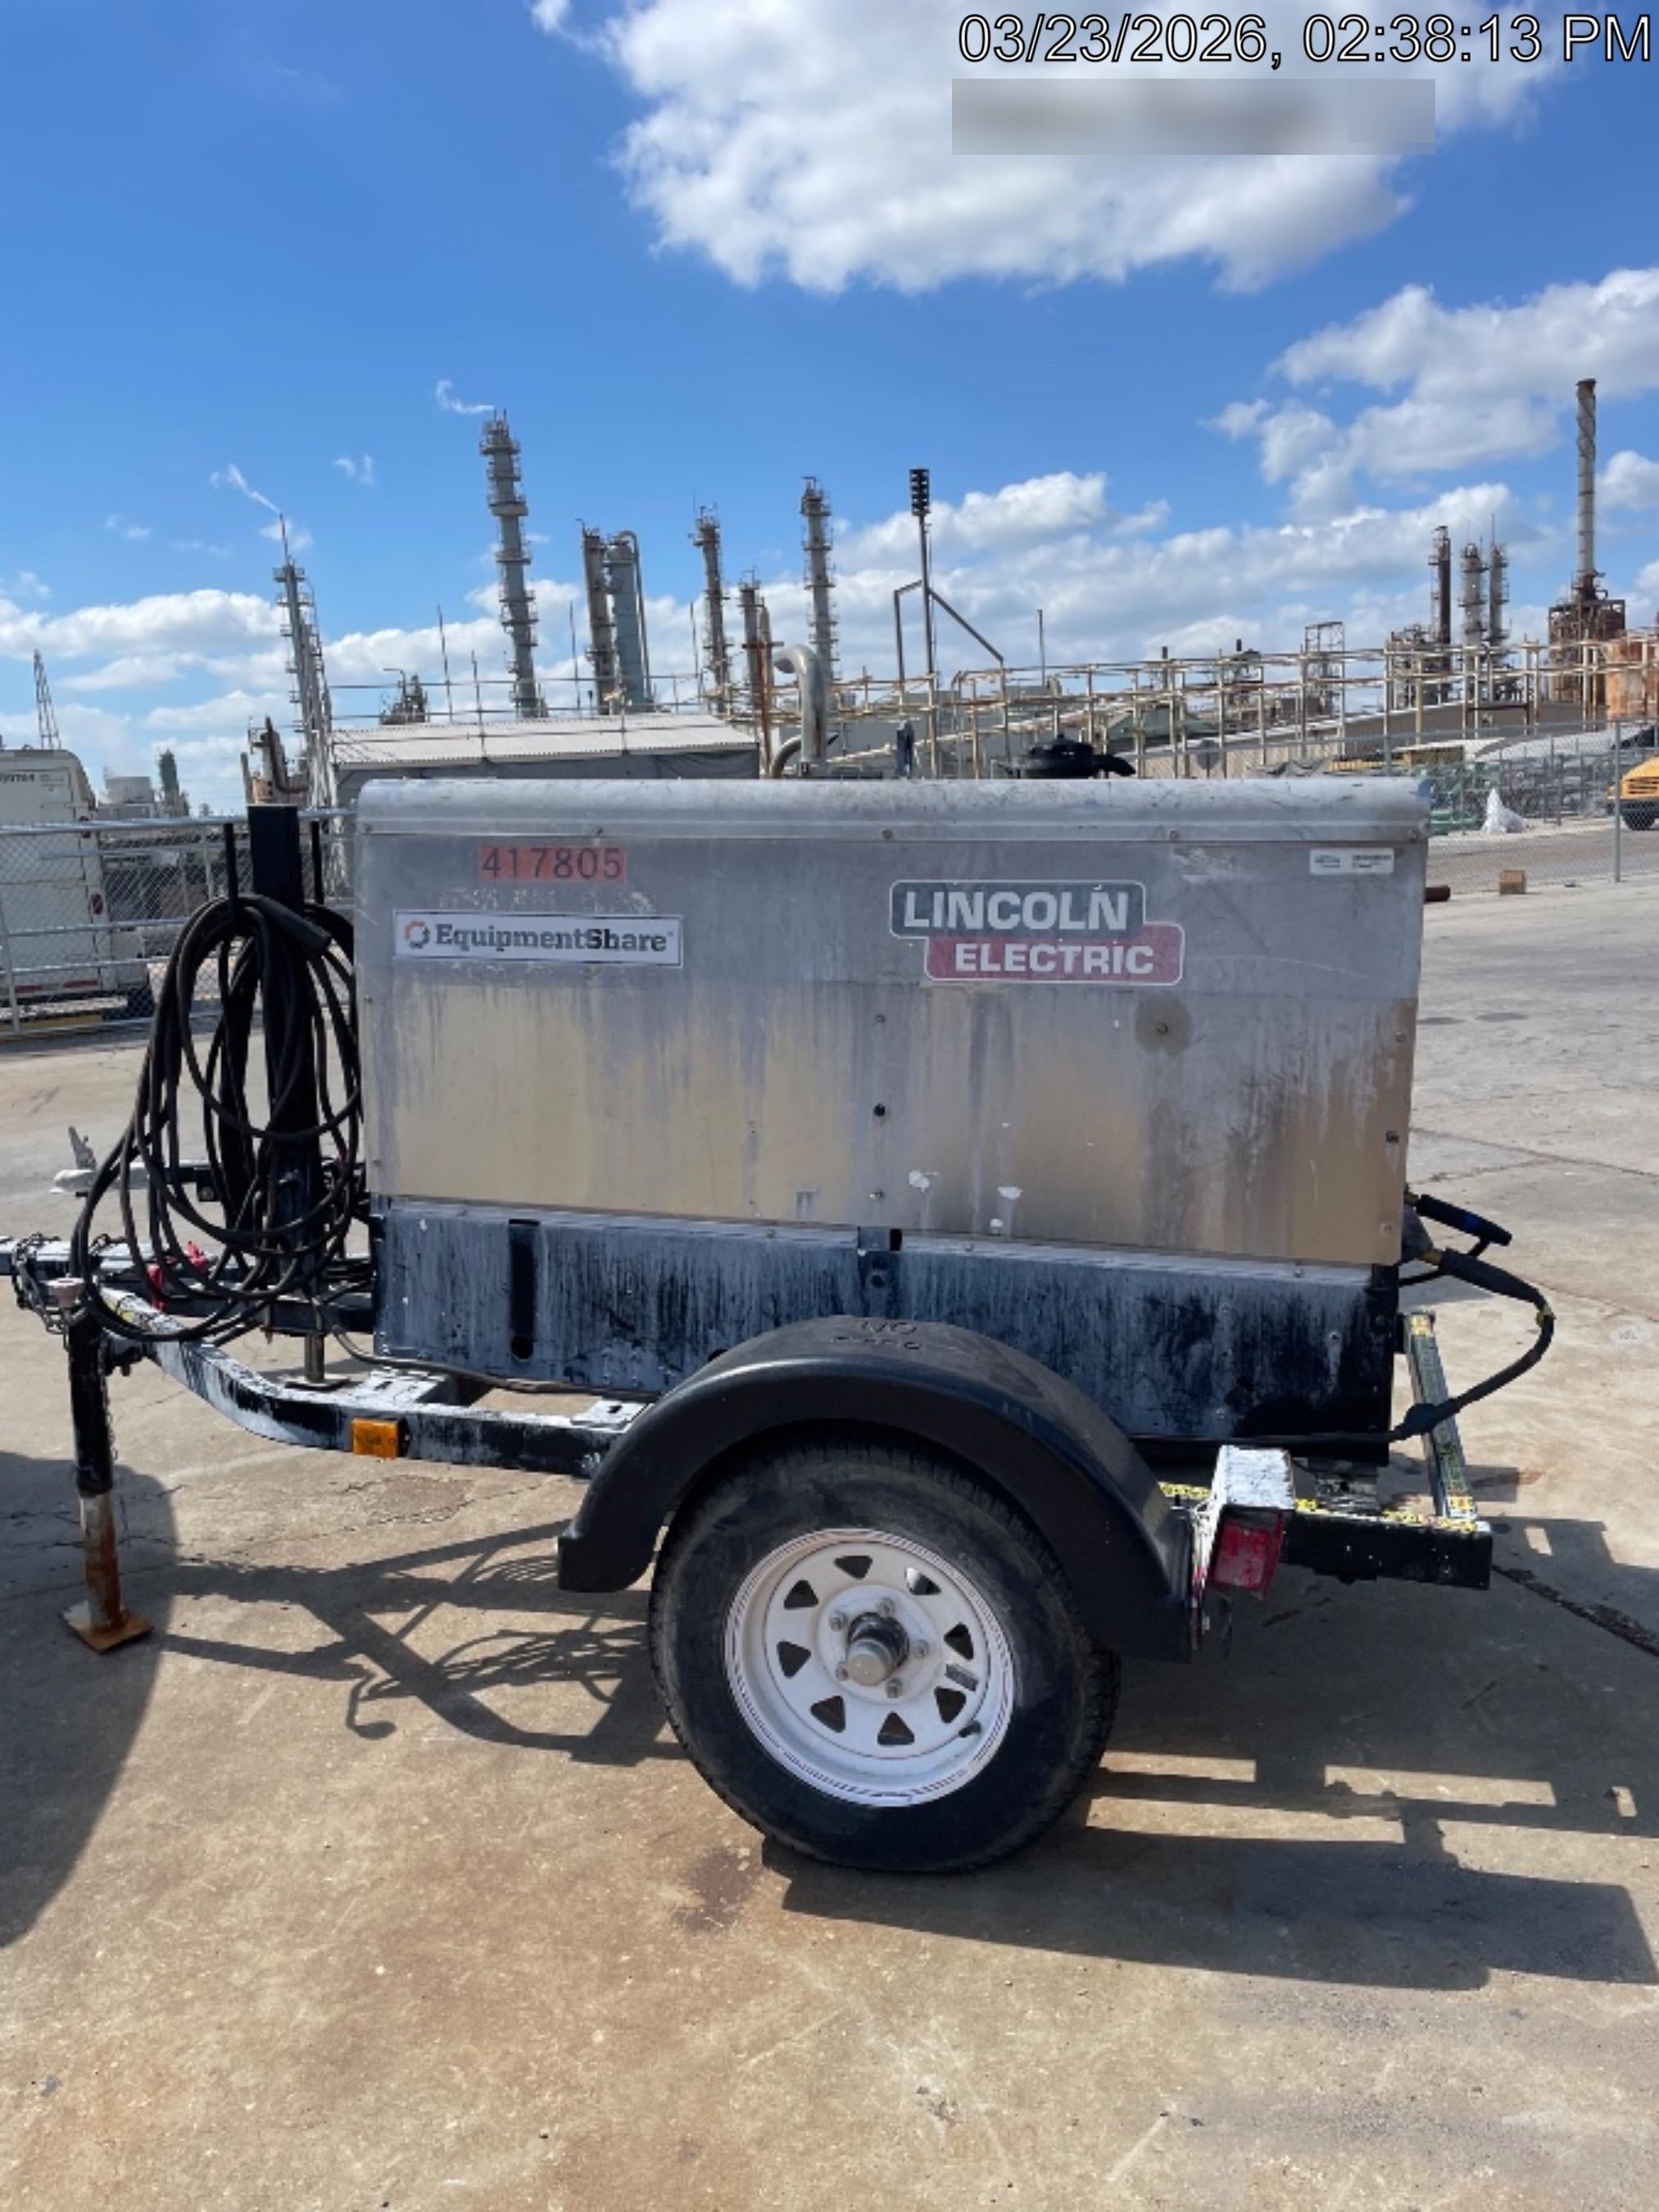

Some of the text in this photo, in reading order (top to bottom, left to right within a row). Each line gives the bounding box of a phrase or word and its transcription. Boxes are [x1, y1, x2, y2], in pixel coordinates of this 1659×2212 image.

[483, 847, 622, 878] 417805
[904, 891, 1128, 930] LINCOLN
[436, 923, 668, 951] EquipmentShare
[955, 943, 1154, 974] ELECTRIC
